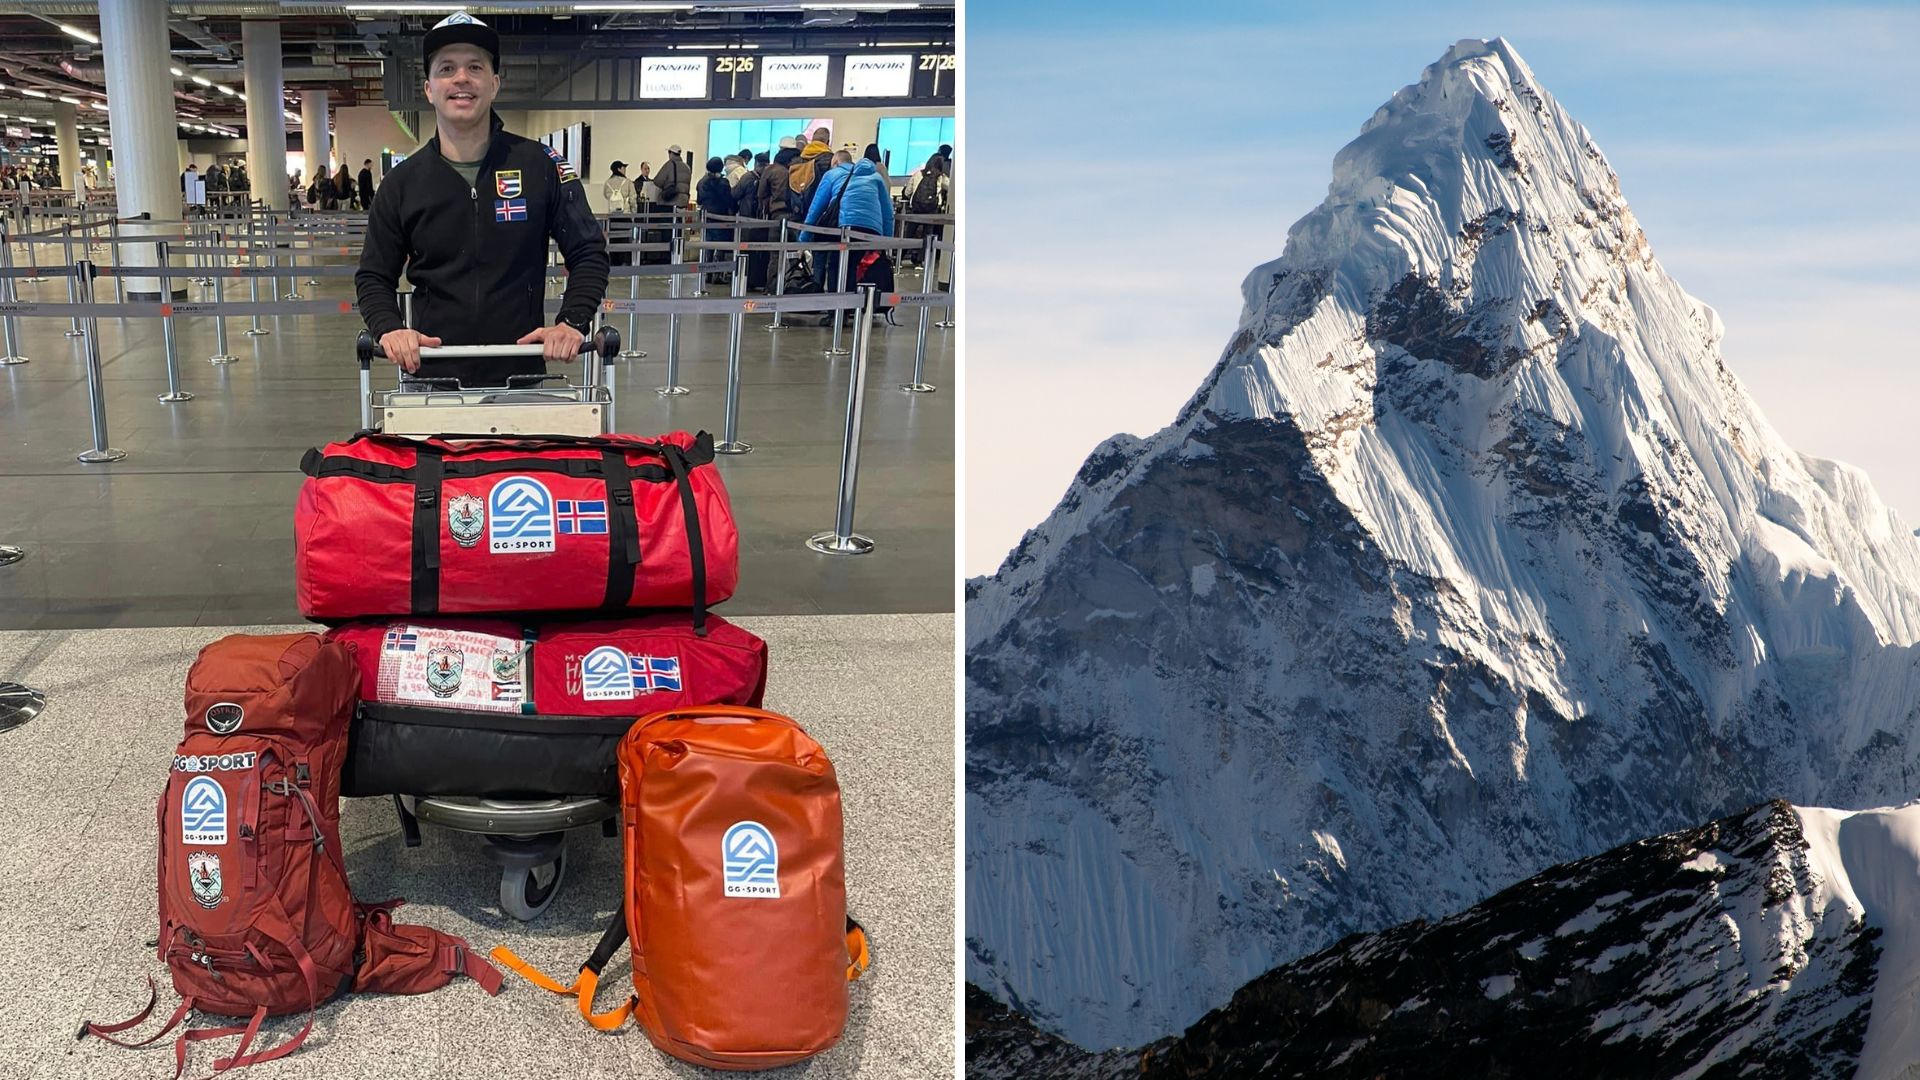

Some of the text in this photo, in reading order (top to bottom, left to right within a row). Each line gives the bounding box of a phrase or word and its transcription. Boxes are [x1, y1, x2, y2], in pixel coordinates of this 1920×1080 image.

[647, 63, 701, 71] FINNAIR
[715, 57, 734, 72] 25
[736, 57, 754, 72] 26
[768, 62, 822, 71] FINNAIR
[852, 62, 905, 70] FINNAIR
[918, 55, 937, 70] 27
[939, 55, 955, 70] 28
[210, 706, 241, 718] OSPREY
